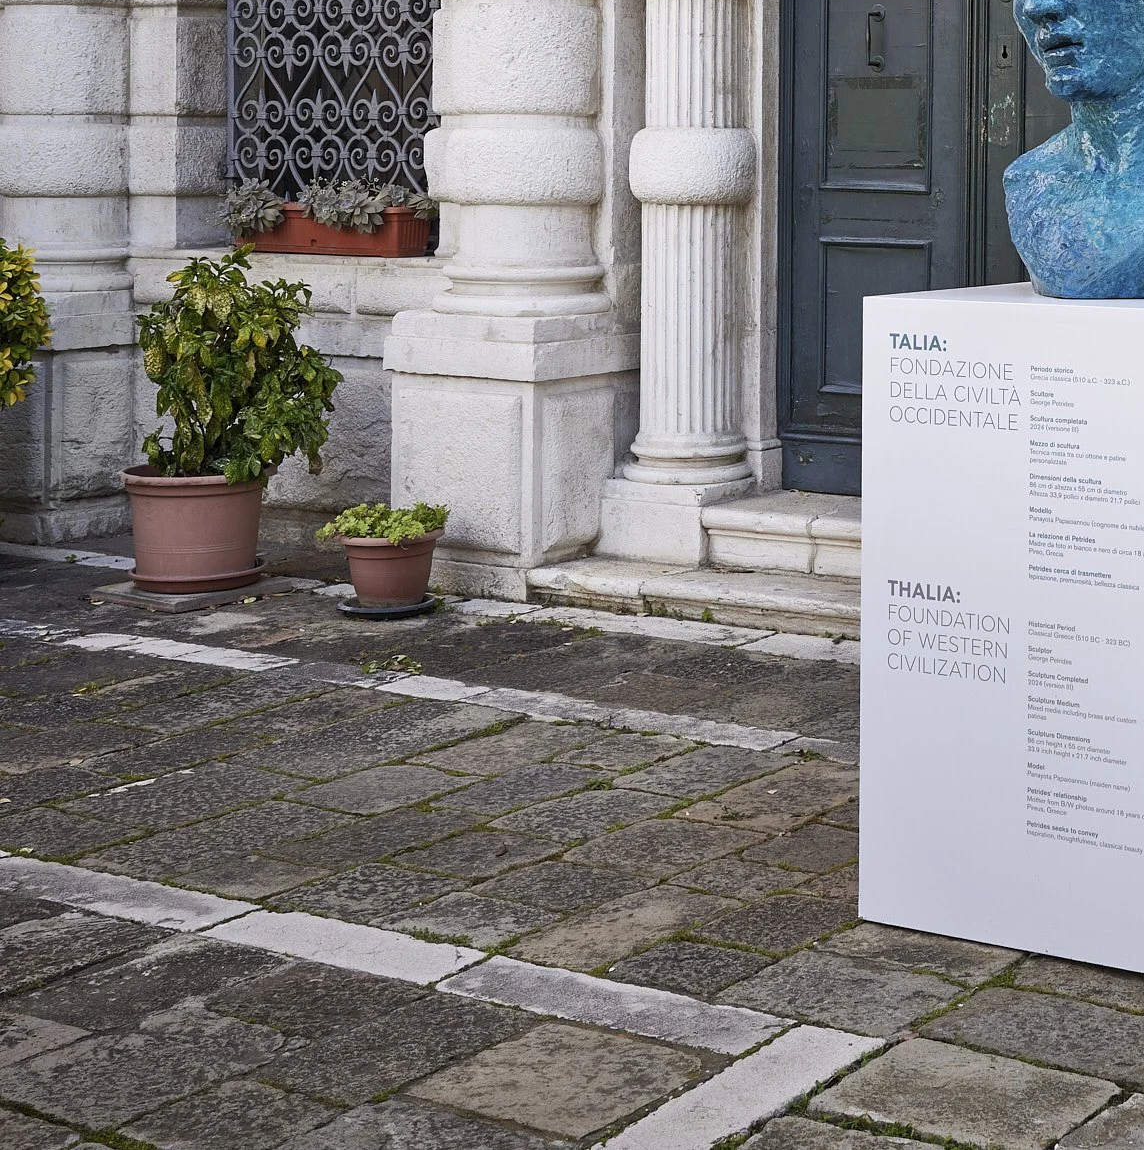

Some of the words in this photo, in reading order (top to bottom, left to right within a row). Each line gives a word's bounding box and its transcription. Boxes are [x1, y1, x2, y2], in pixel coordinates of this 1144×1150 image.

[889, 333, 947, 352] TALIA:
[890, 357, 1013, 381] FONDAZIONE
[890, 381, 948, 401] DELLA
[954, 385, 1021, 406] CIVILTÀ
[1030, 390, 1054, 398] Scultore
[889, 406, 1018, 431] OCCIDENTALE
[1030, 473, 1061, 482] Dimensioni
[1029, 506, 1052, 514] Modello
[1072, 535, 1096, 543] Petrides
[1029, 564, 1052, 573] Petrides
[888, 580, 961, 604] THALIA:
[888, 604, 1010, 634] FOUNDATION
[1028, 620, 1056, 629] Historical
[1057, 623, 1076, 631] Period
[888, 628, 912, 646] OF
[918, 632, 1008, 659] WESTERN
[888, 653, 1006, 684] CIVILIZATION
[1028, 670, 1056, 680] Sculpture
[1057, 674, 1089, 684] Completed
[1027, 695, 1056, 705] Sculpture
[1057, 699, 1080, 708] Medium
[1027, 729, 1055, 738] Sculpture
[1056, 733, 1091, 743] Dimensions
[1027, 762, 1045, 770] Model
[1026, 820, 1050, 830] Petrides
[1078, 830, 1099, 838] convey
